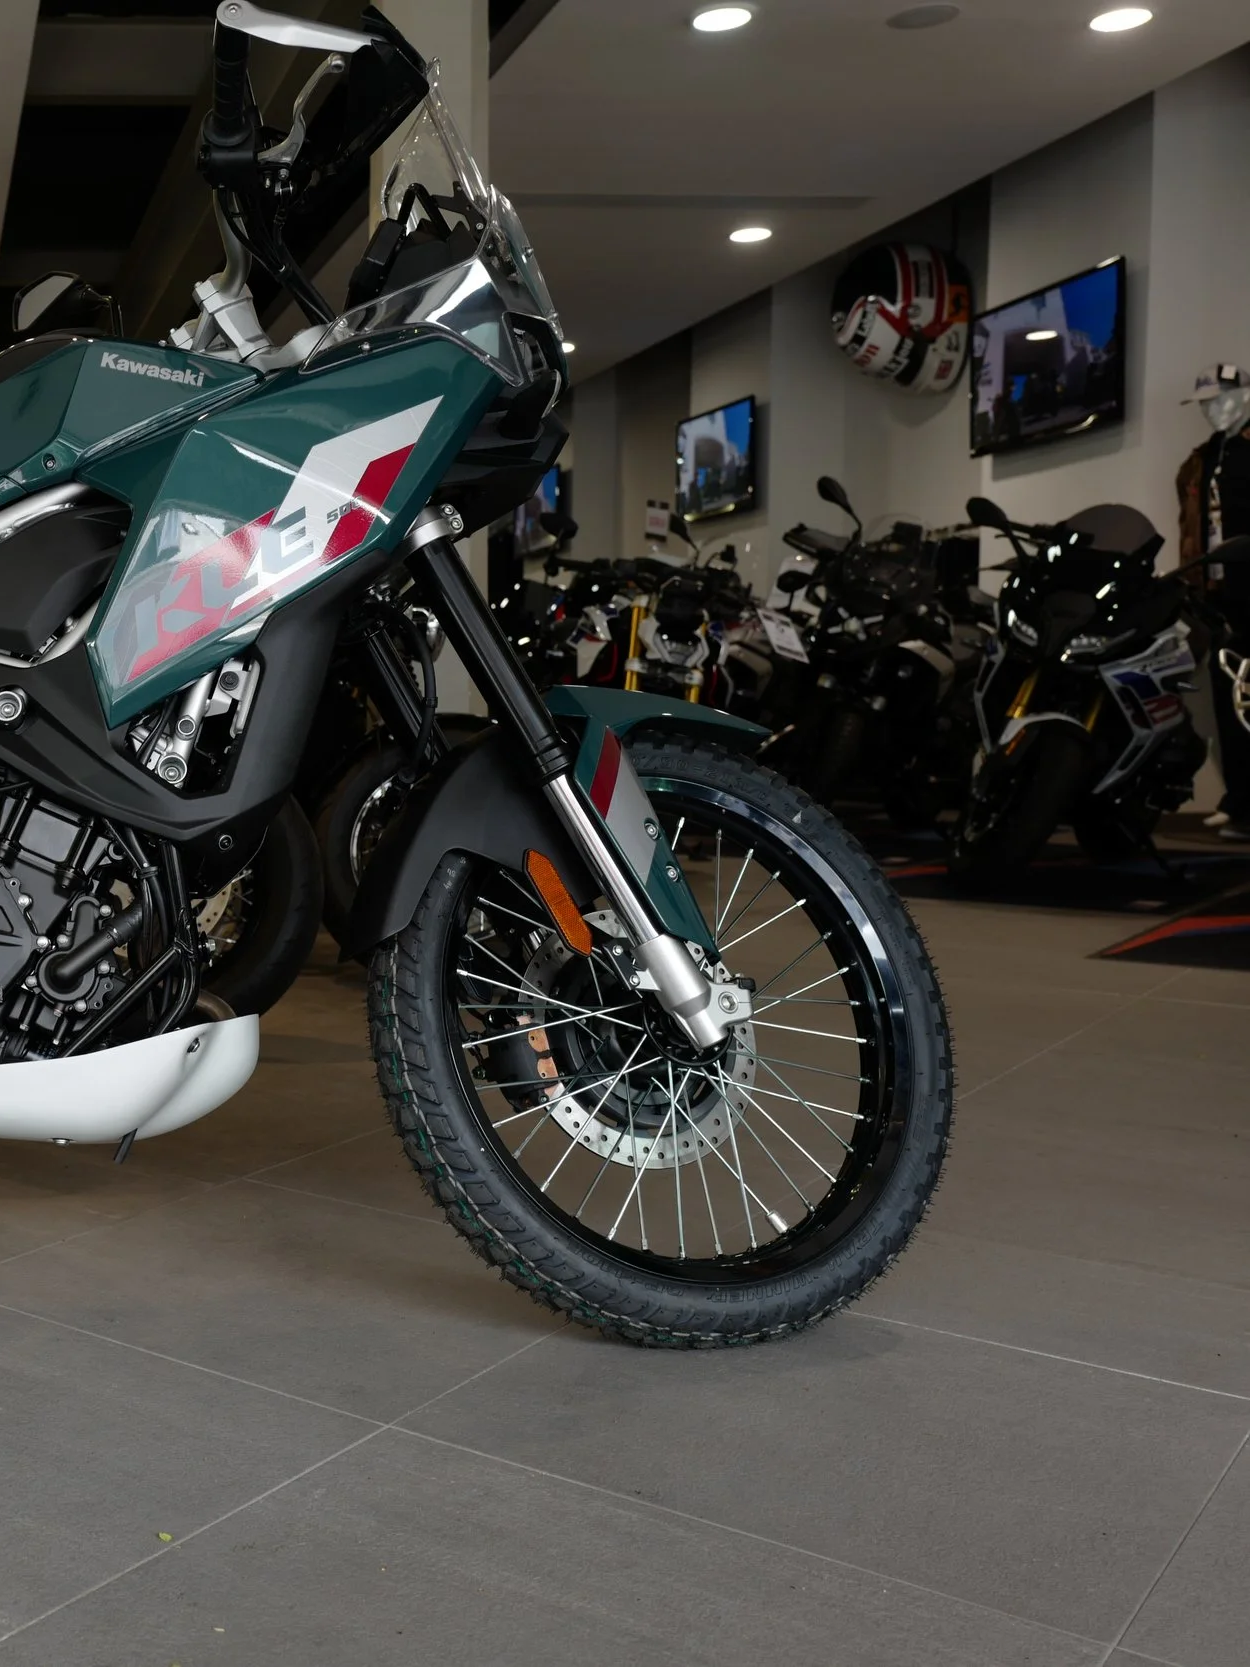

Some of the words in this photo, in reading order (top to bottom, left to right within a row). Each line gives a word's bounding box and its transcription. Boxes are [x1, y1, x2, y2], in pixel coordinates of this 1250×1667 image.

[100, 352, 205, 387] Kawasaki
[134, 506, 315, 655] KLE
[710, 1271, 814, 1304] WINNER
